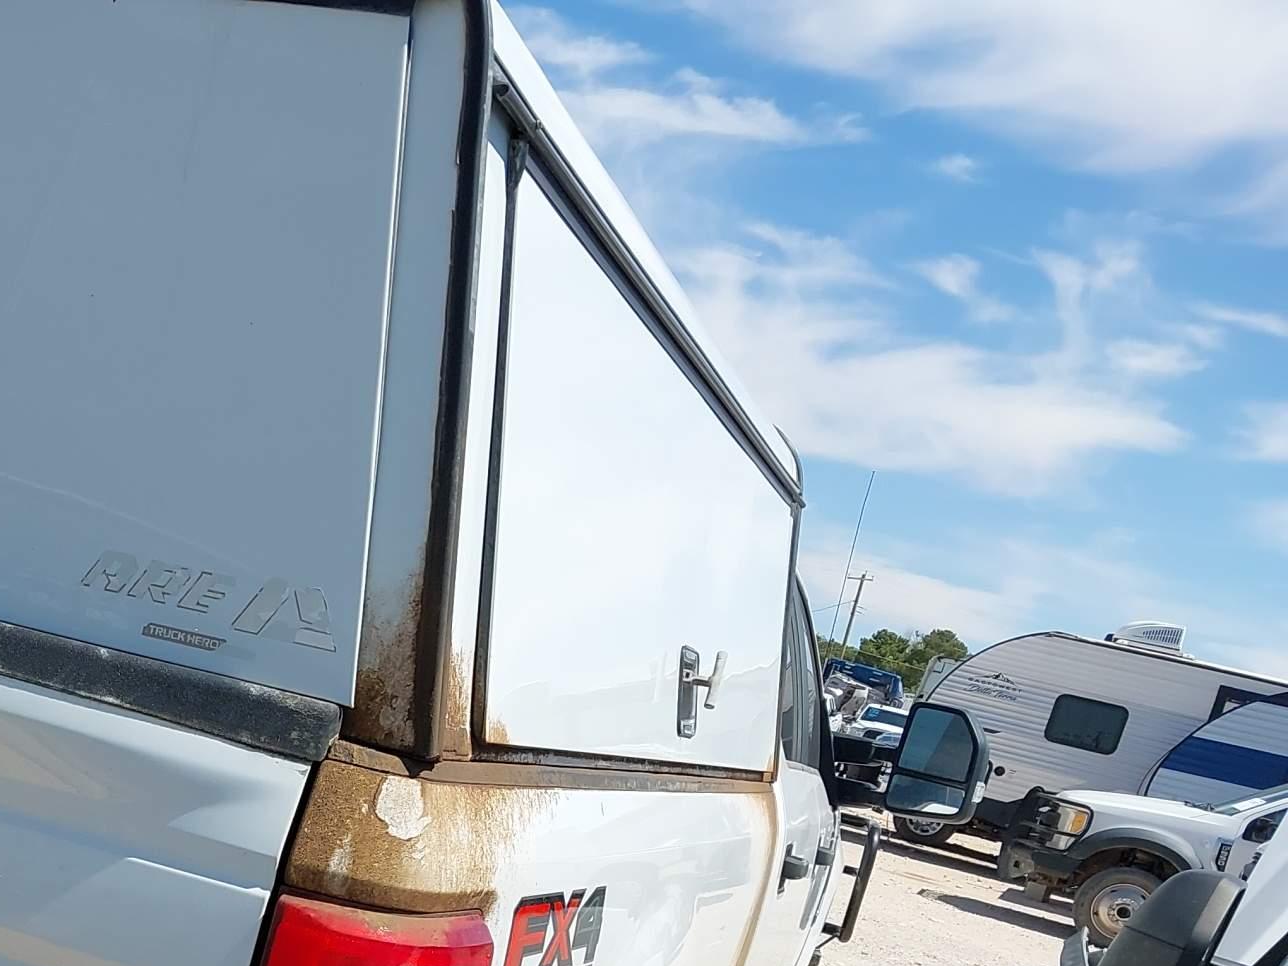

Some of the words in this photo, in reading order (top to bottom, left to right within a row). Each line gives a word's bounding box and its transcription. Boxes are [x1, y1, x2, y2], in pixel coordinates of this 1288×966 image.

[80, 550, 235, 614] ARE
[148, 624, 186, 643] TRUCK
[187, 633, 221, 650] HERO
